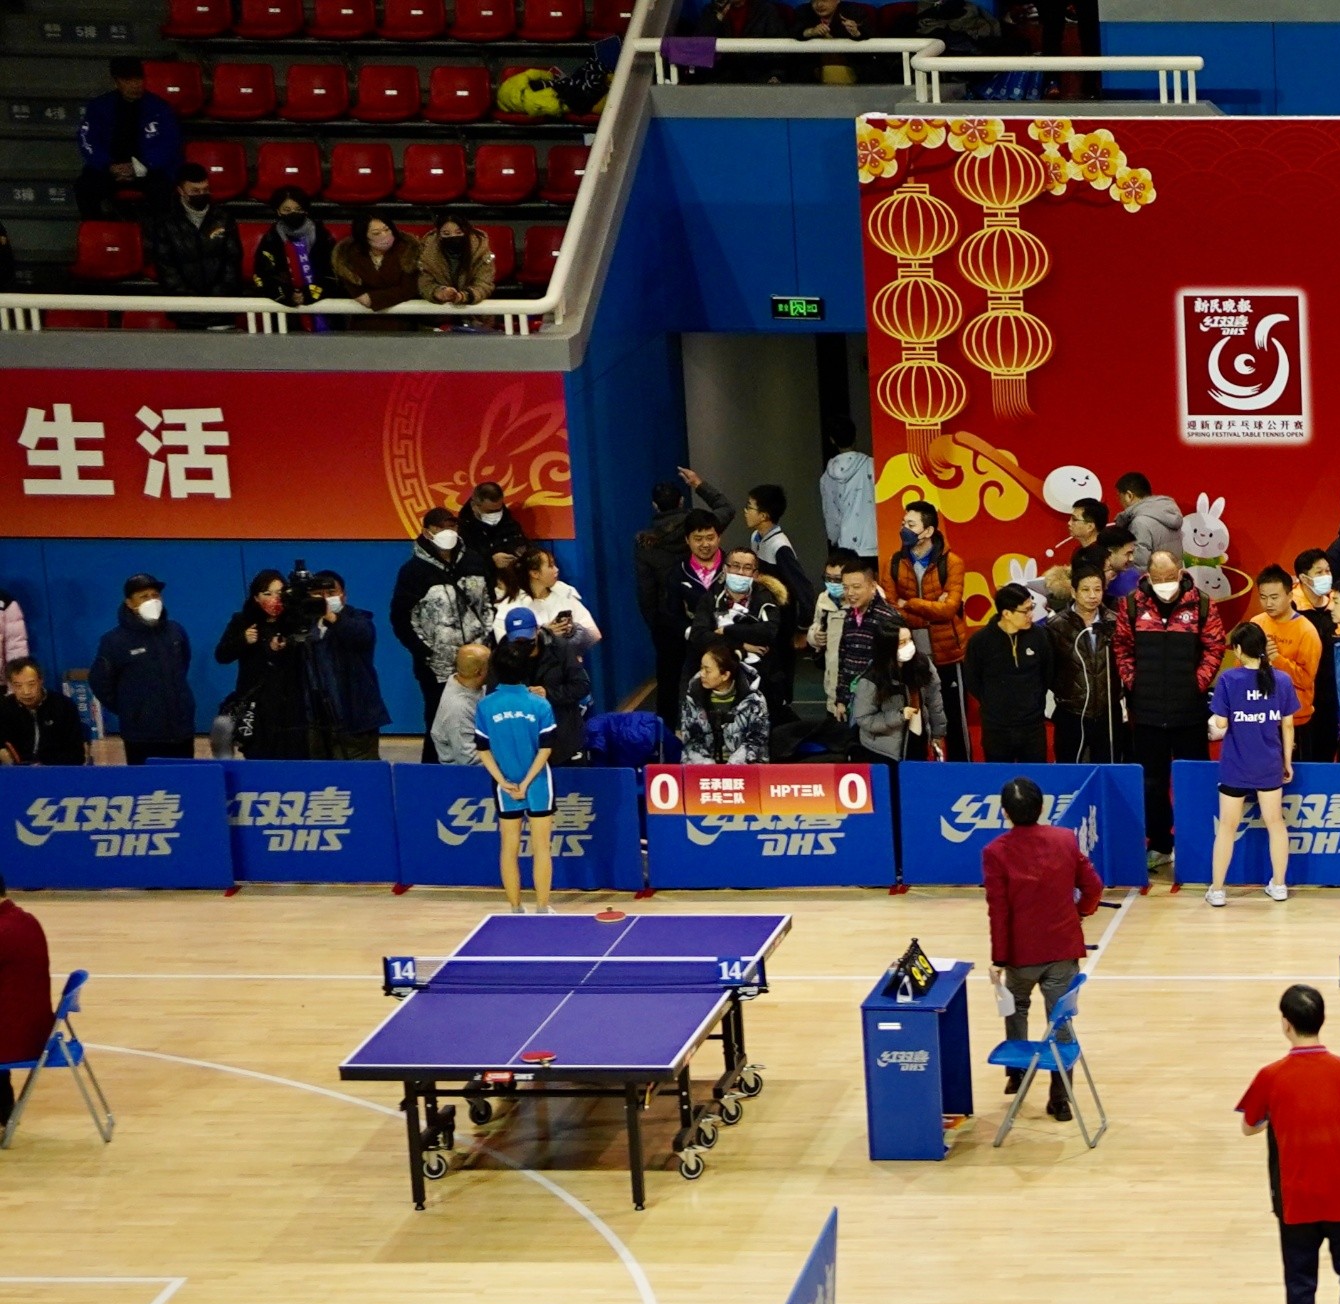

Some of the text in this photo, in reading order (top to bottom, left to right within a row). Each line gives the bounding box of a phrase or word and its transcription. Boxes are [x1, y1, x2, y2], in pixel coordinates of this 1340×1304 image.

[1221, 327, 1248, 336] DHS
[1187, 419, 1304, 431] 迎新春乒乓球公开赛
[17, 403, 232, 499] 生活
[650, 773, 679, 810] 0
[699, 791, 745, 805] 乒乓二队
[770, 784, 825, 798] HPT三队
[838, 773, 867, 809] 0
[16, 790, 183, 847] 红双喜
[437, 792, 597, 846] 红喜
[89, 832, 181, 857] DHS
[262, 828, 351, 852] DHS
[757, 832, 845, 856] DHS
[391, 960, 415, 982] 14
[719, 960, 743, 981] 14
